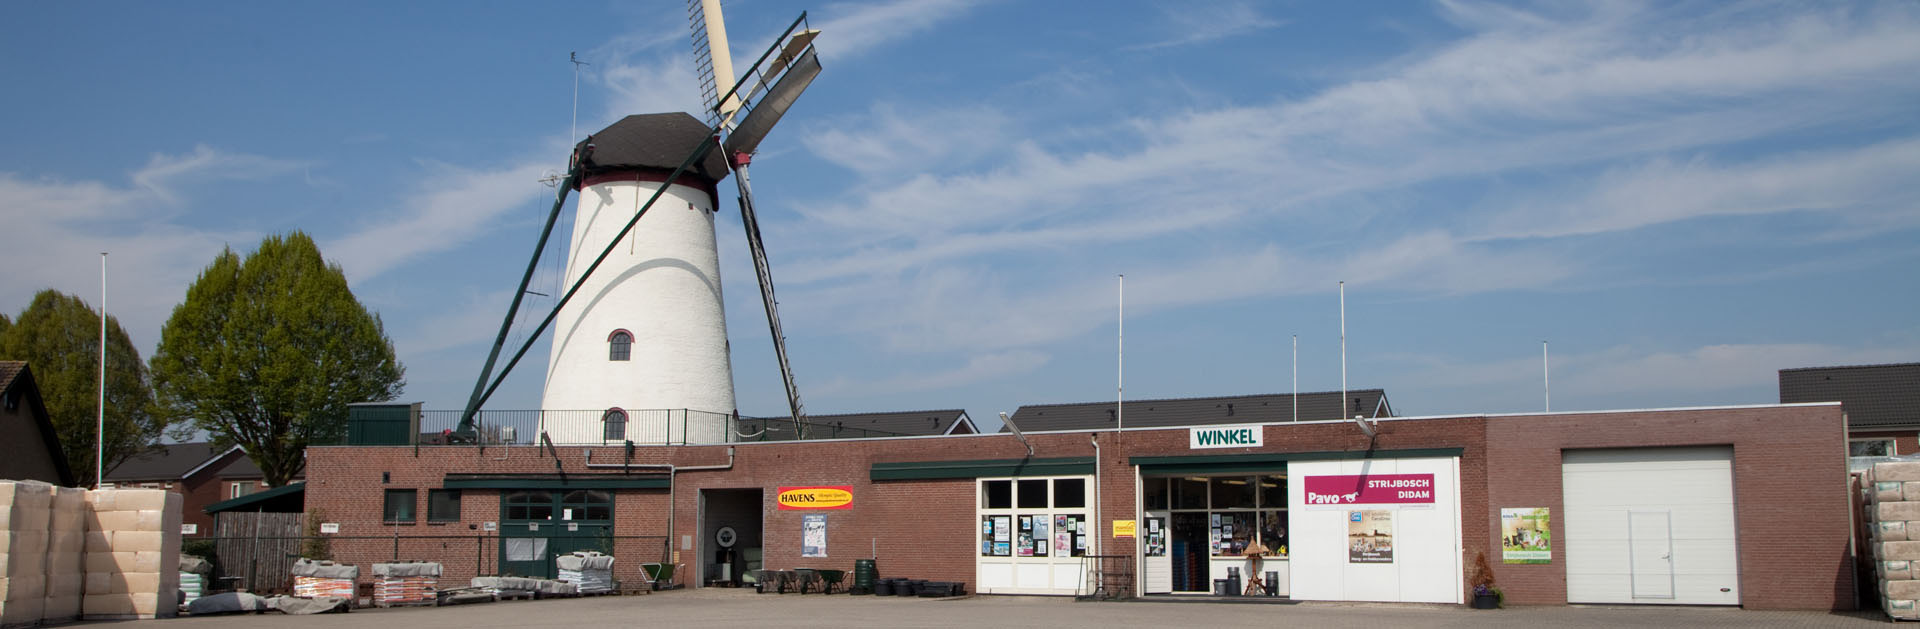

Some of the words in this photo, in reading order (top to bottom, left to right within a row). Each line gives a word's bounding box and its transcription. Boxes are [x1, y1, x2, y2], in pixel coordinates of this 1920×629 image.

[1197, 429, 1256, 445] WINKEL
[1368, 479, 1430, 488] STRIJBOSCH
[781, 494, 815, 502] HAVENS
[1308, 492, 1340, 503] Pavo
[1398, 490, 1430, 499] DIDAM
